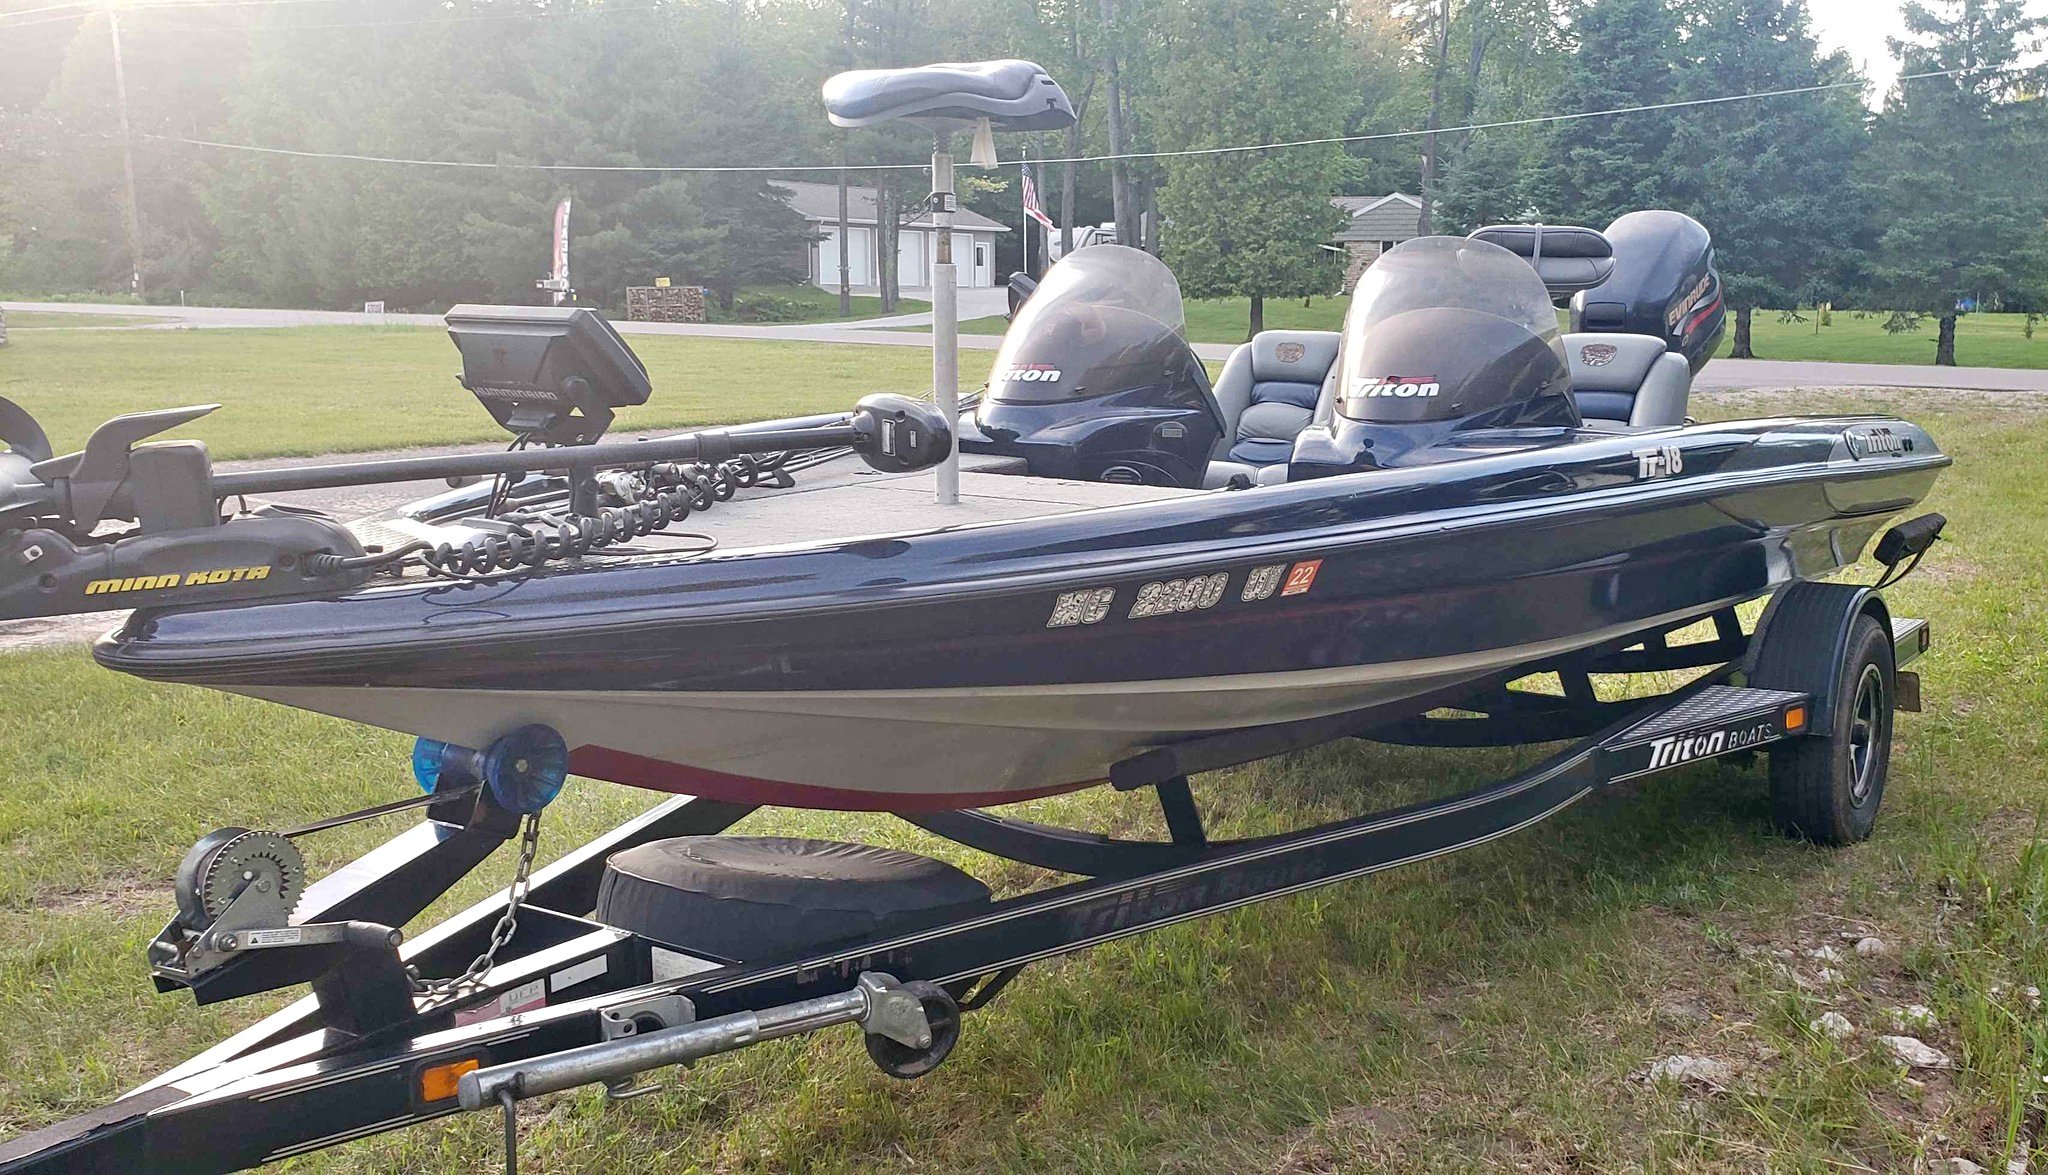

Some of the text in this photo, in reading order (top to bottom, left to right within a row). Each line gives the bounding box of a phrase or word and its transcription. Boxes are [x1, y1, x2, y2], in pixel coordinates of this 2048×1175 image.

[1669, 272, 1709, 326] EVINRUDE
[85, 566, 271, 595] MINN KOTA
[1128, 572, 1228, 618] 2200
[1289, 567, 1314, 586] 22
[1649, 723, 1773, 769] Triton BOATS
